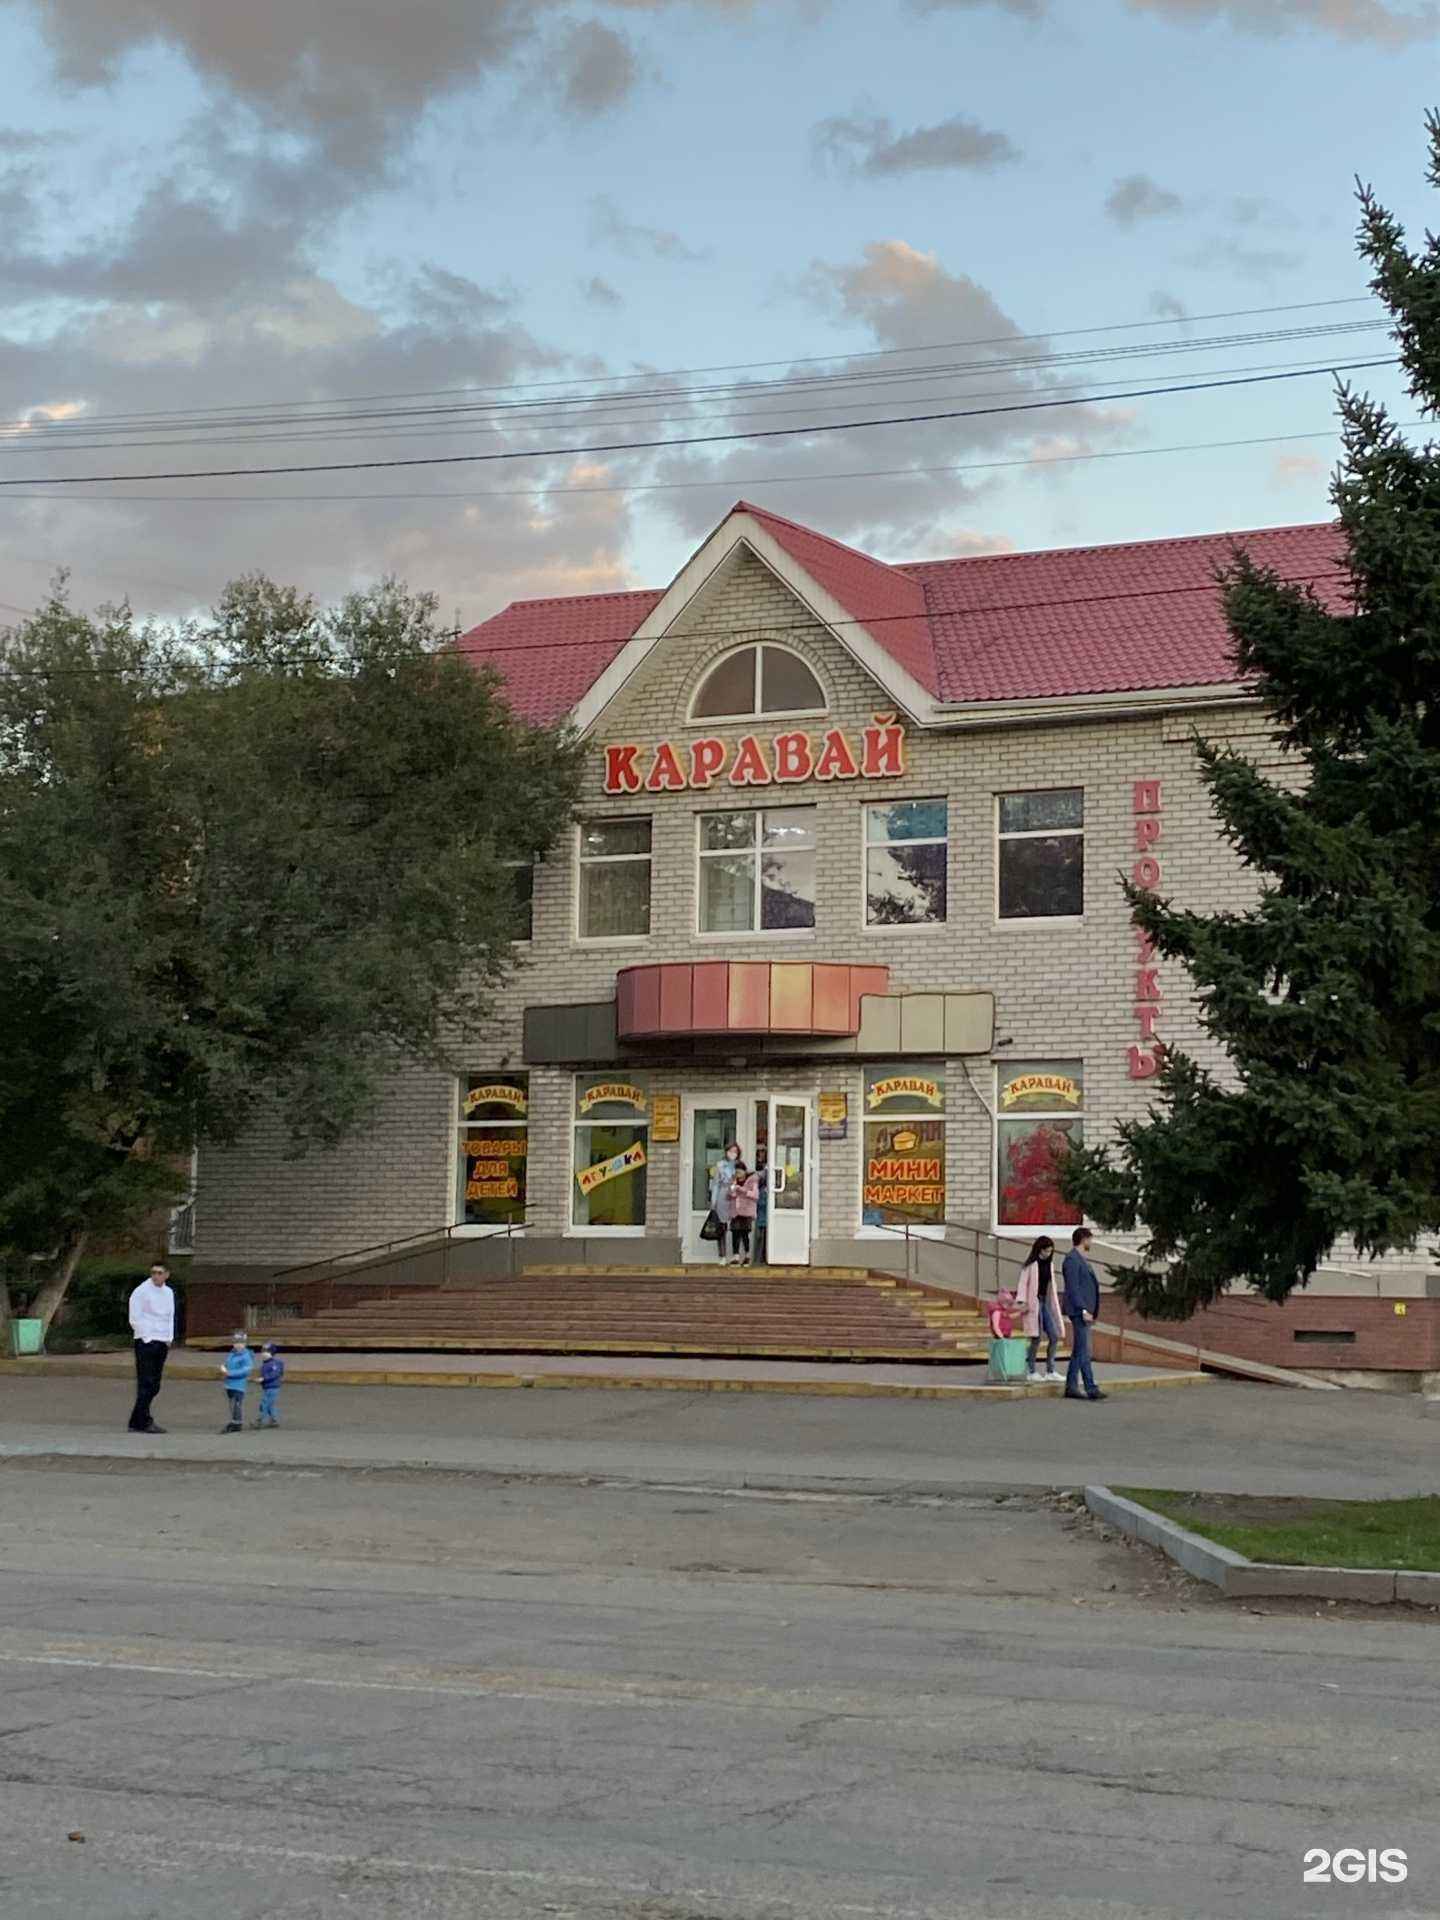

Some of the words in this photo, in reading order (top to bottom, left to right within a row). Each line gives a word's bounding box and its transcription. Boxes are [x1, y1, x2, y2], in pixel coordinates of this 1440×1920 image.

[603, 713, 905, 794] КАРАВАЙ
[1126, 780, 1167, 1080] ПРОУКТЫ
[462, 1140, 528, 1156] ТОВАРЫ
[473, 1160, 509, 1179] ДЛЯ
[868, 1158, 940, 1181] МИНИ
[466, 1178, 518, 1199] ДЕТЕЙ
[864, 1184, 944, 1205] МАРКЕТ
